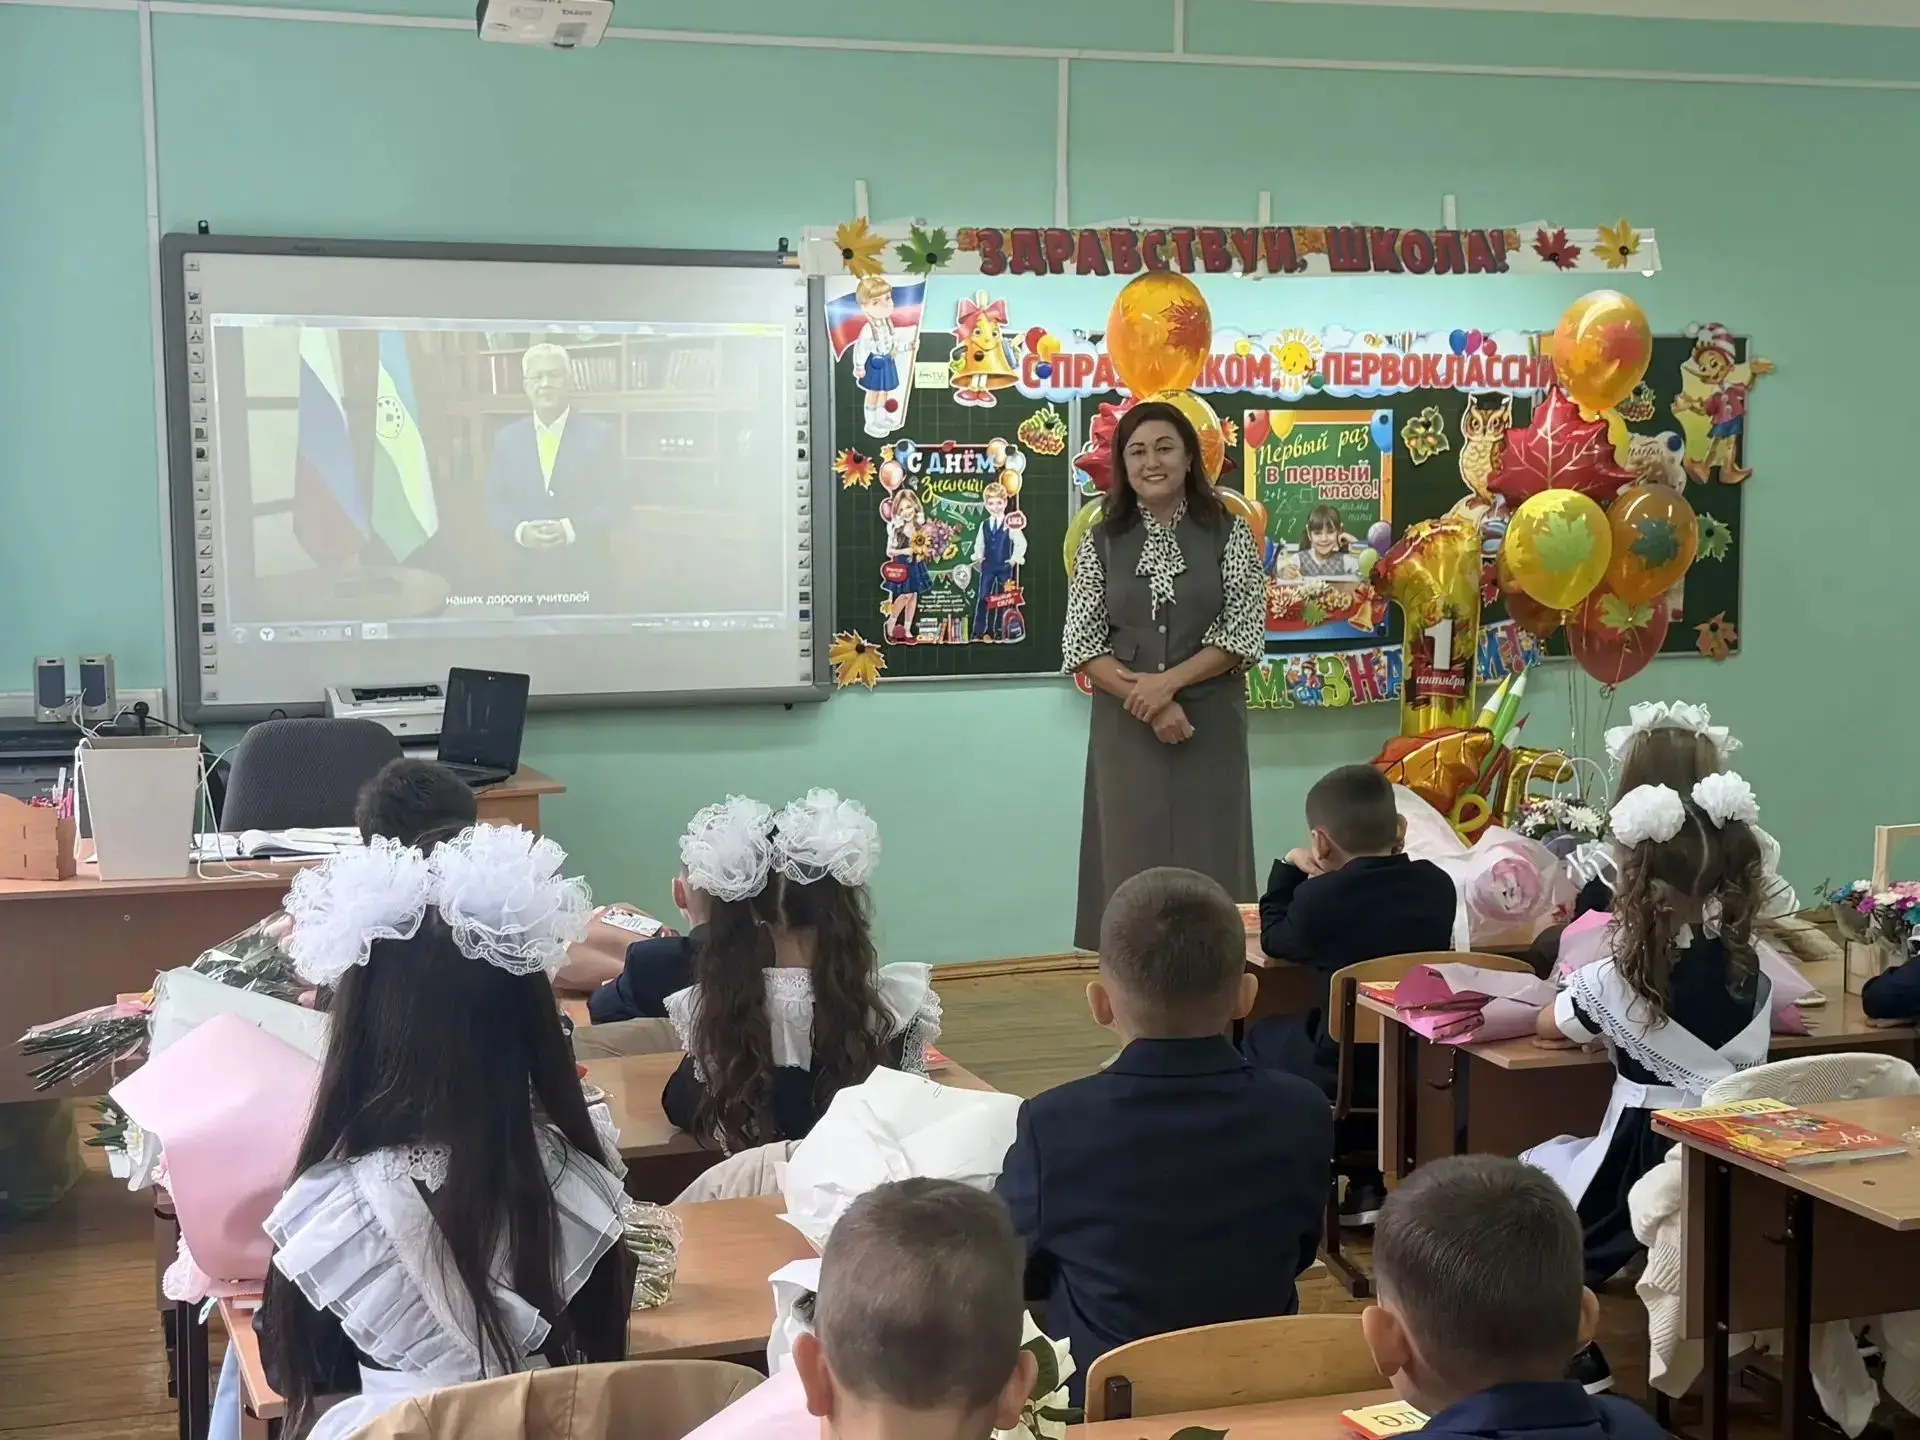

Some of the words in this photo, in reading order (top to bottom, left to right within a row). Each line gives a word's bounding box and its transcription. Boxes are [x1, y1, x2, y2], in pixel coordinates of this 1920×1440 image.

[1325, 226, 1509, 275] ШКОЛА!
[1022, 353, 1041, 389] С
[1050, 353, 1281, 393] ПРАКОМ,
[1322, 352, 1558, 388] ПЕРВОКЛАССНИ
[907, 452, 922, 473] С
[926, 449, 996, 474] ДНЁМ
[1259, 429, 1329, 472] Первый
[1337, 425, 1370, 458] раз
[1285, 459, 1371, 488] первый
[921, 475, 983, 504] Знаний
[1318, 478, 1380, 500] класс!
[446, 594, 484, 606] наших
[486, 593, 534, 606] дорогих
[536, 590, 590, 605] учителей
[1424, 618, 1454, 671] 1
[1416, 674, 1466, 690] сентября
